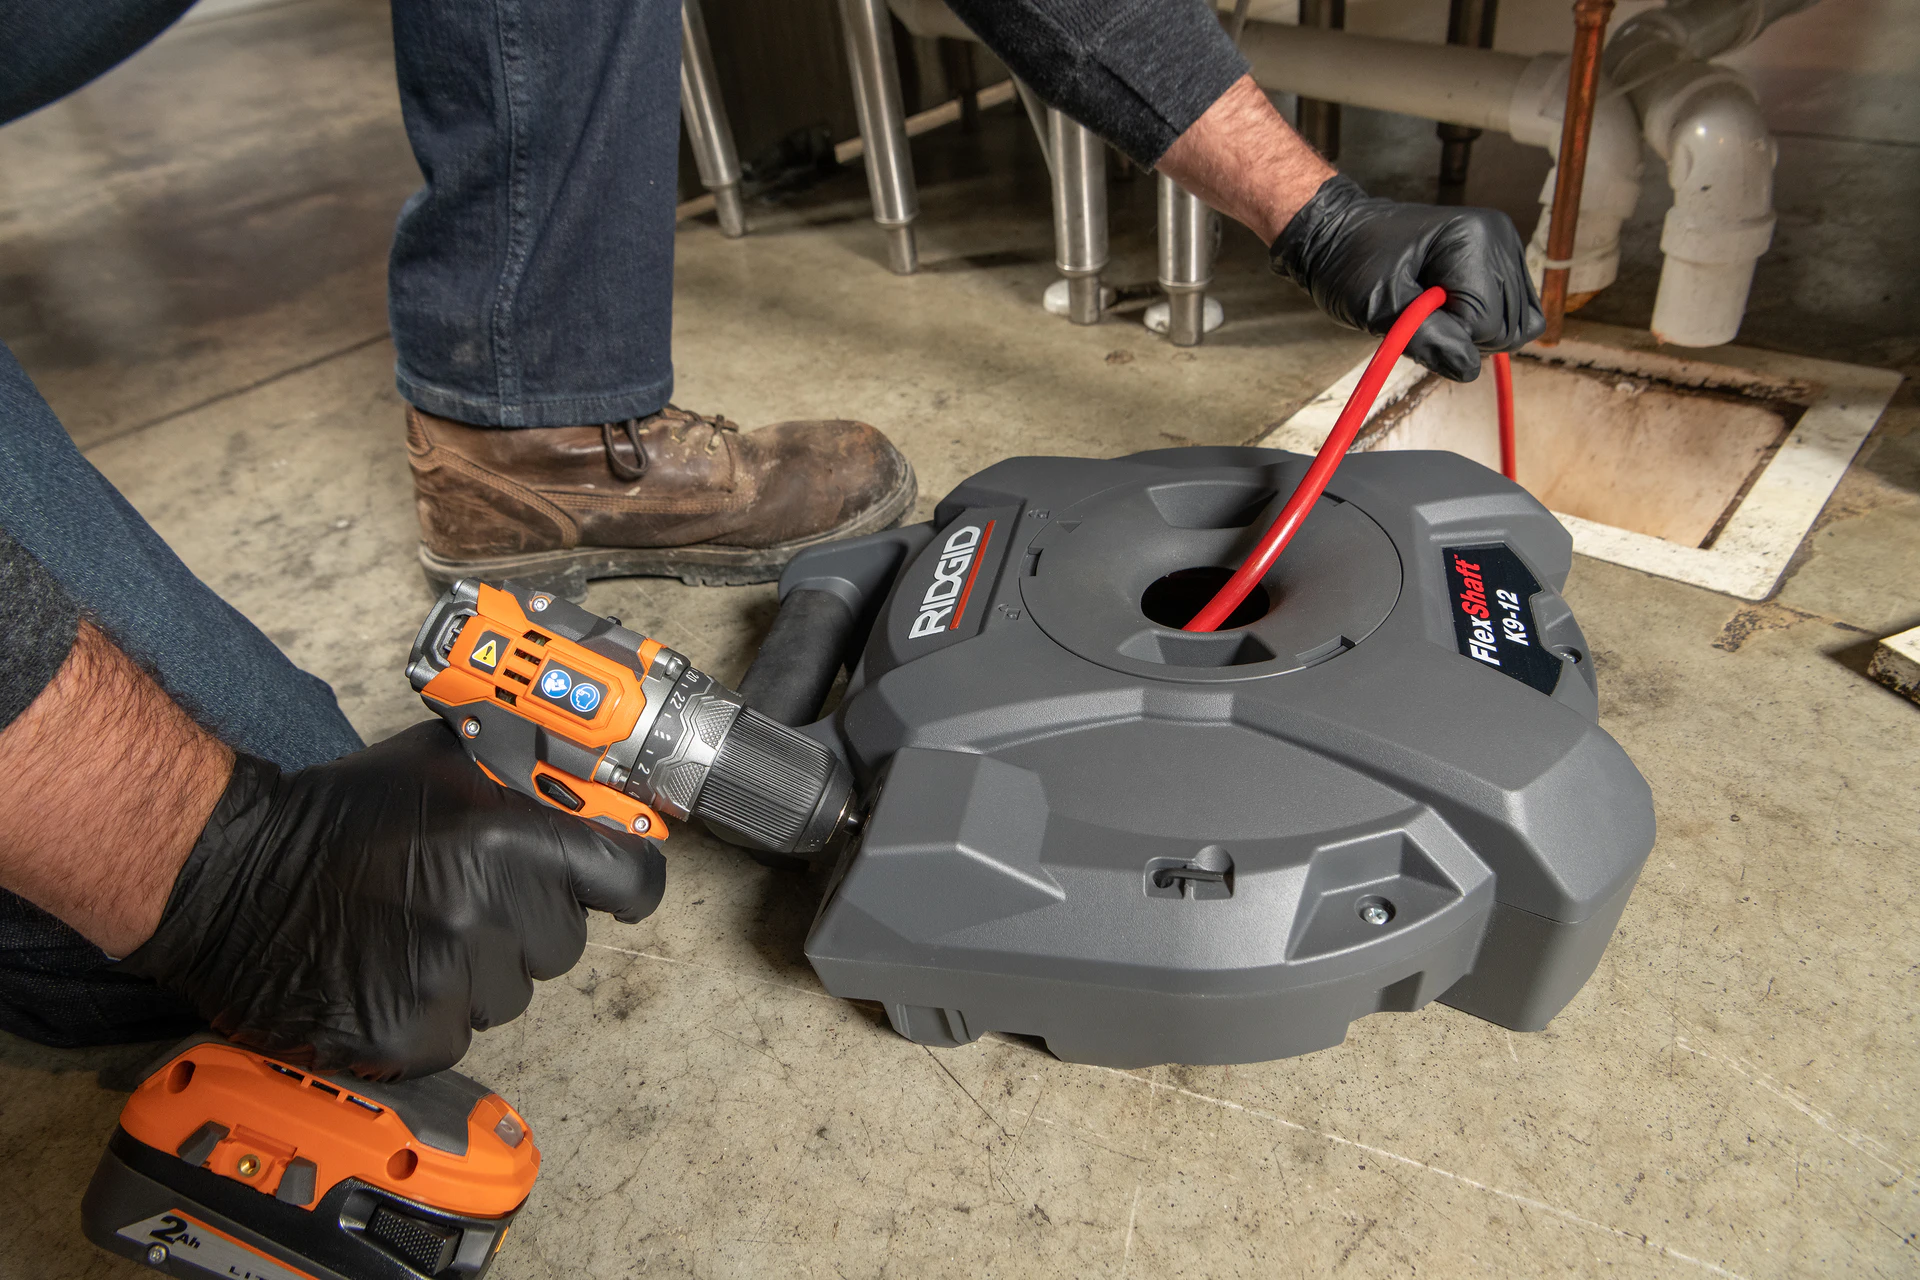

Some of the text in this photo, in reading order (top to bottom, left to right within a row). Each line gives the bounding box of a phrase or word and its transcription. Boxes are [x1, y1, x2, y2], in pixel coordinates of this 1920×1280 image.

[908, 525, 981, 640] RIDGID
[1496, 589, 1530, 646] K9-12
[685, 670, 700, 683] 20
[669, 690, 686, 710] 22
[637, 762, 650, 775] 2
